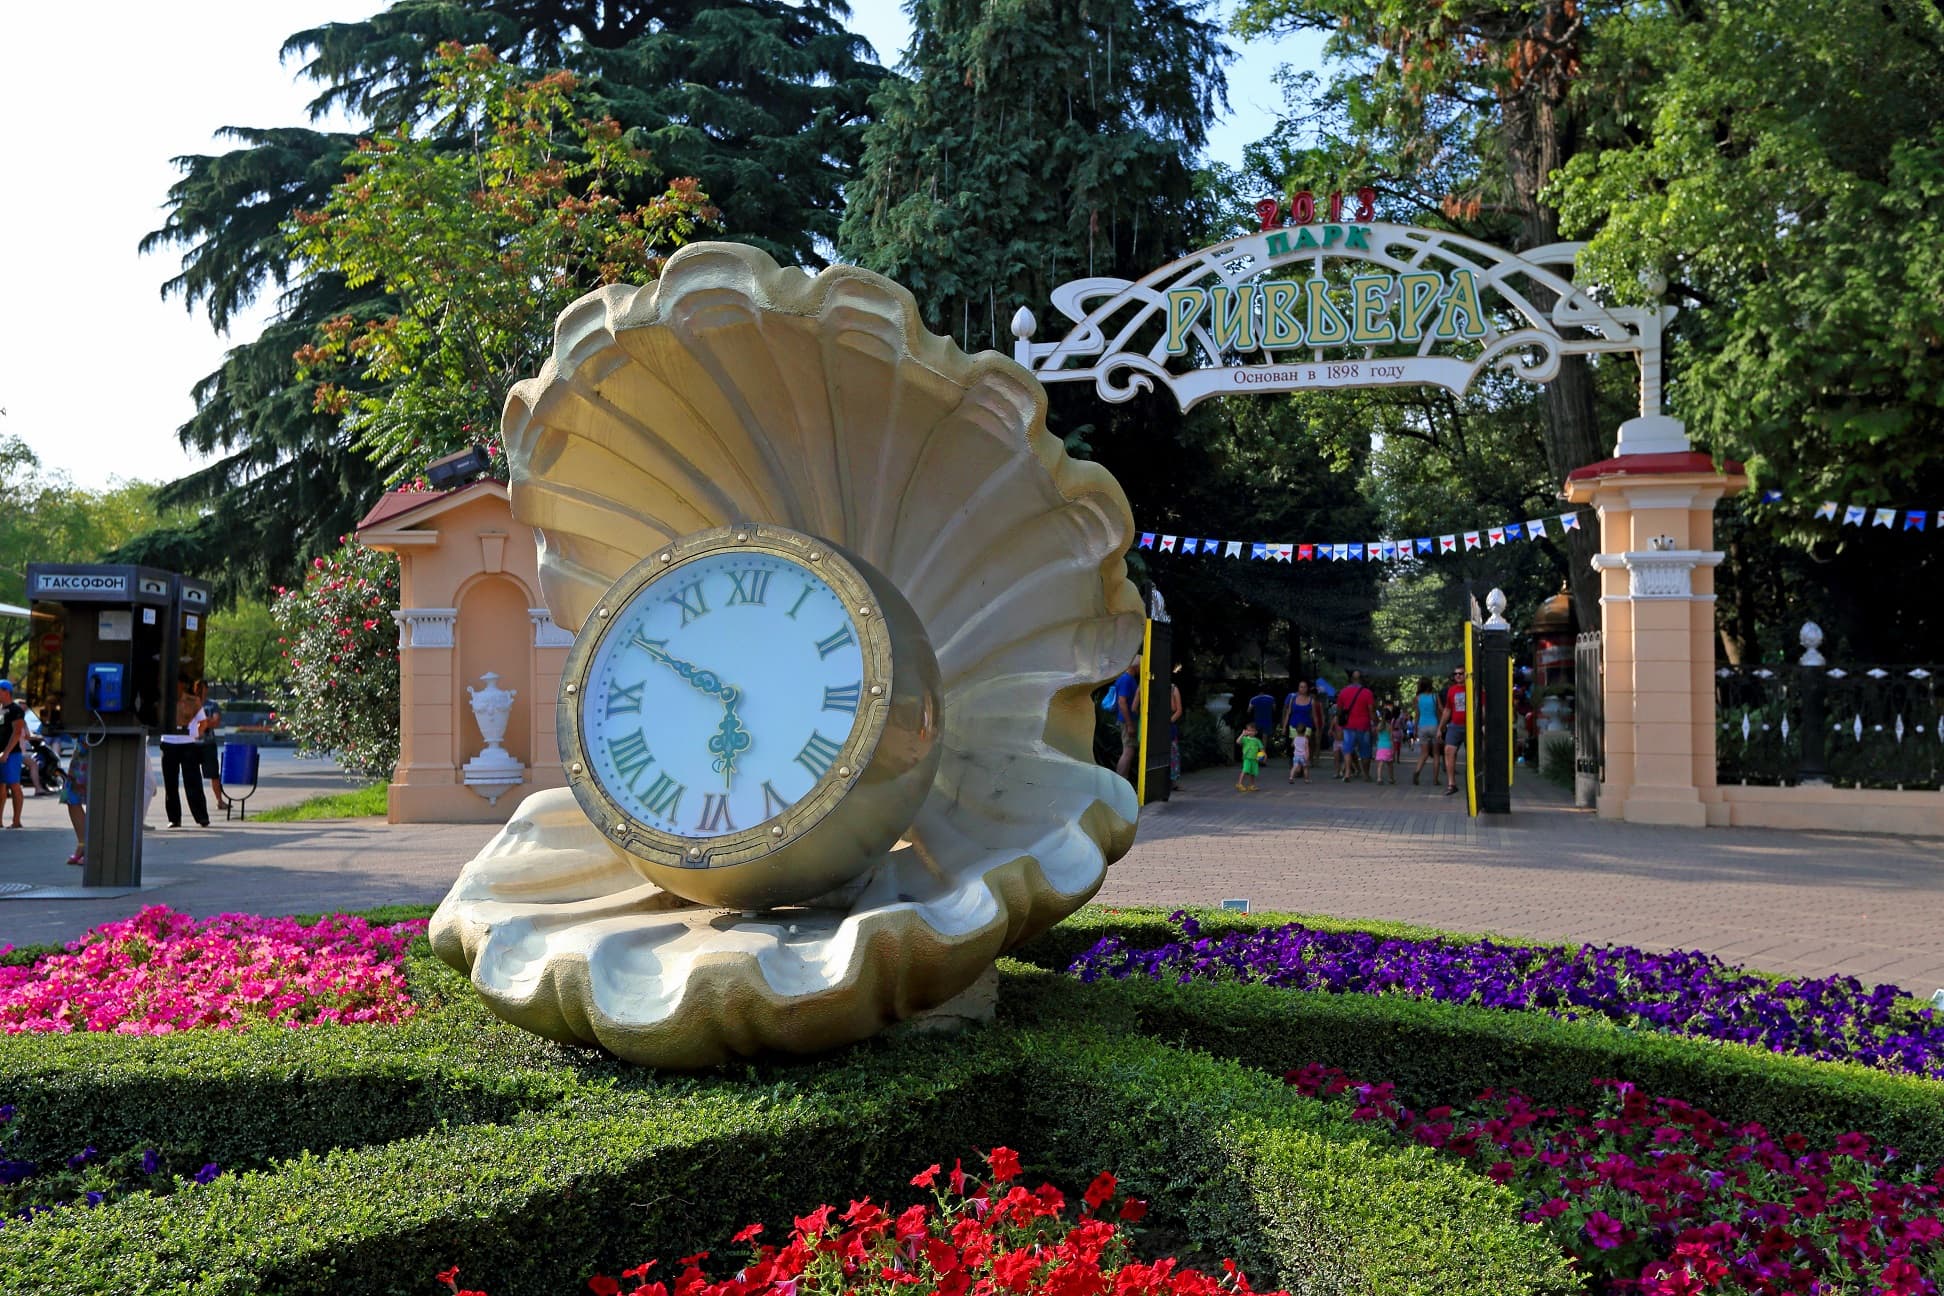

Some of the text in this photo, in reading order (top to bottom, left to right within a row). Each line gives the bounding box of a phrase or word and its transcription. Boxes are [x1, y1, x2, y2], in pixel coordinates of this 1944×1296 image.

[1256, 187, 1376, 231] 2013
[1266, 225, 1371, 257] ПАРК
[1165, 268, 1487, 354] РИВЬЕРА
[1233, 364, 1405, 384] Основан в 1898 году
[42, 577, 124, 589] ТАКСОФОН
[725, 570, 774, 606] XII
[784, 583, 817, 620] I
[664, 577, 711, 629] XI
[814, 622, 855, 660] II
[605, 676, 647, 720] IX
[821, 680, 862, 717] III
[607, 726, 656, 793] VIII
[635, 768, 688, 826] VII
[694, 793, 738, 832] VI
